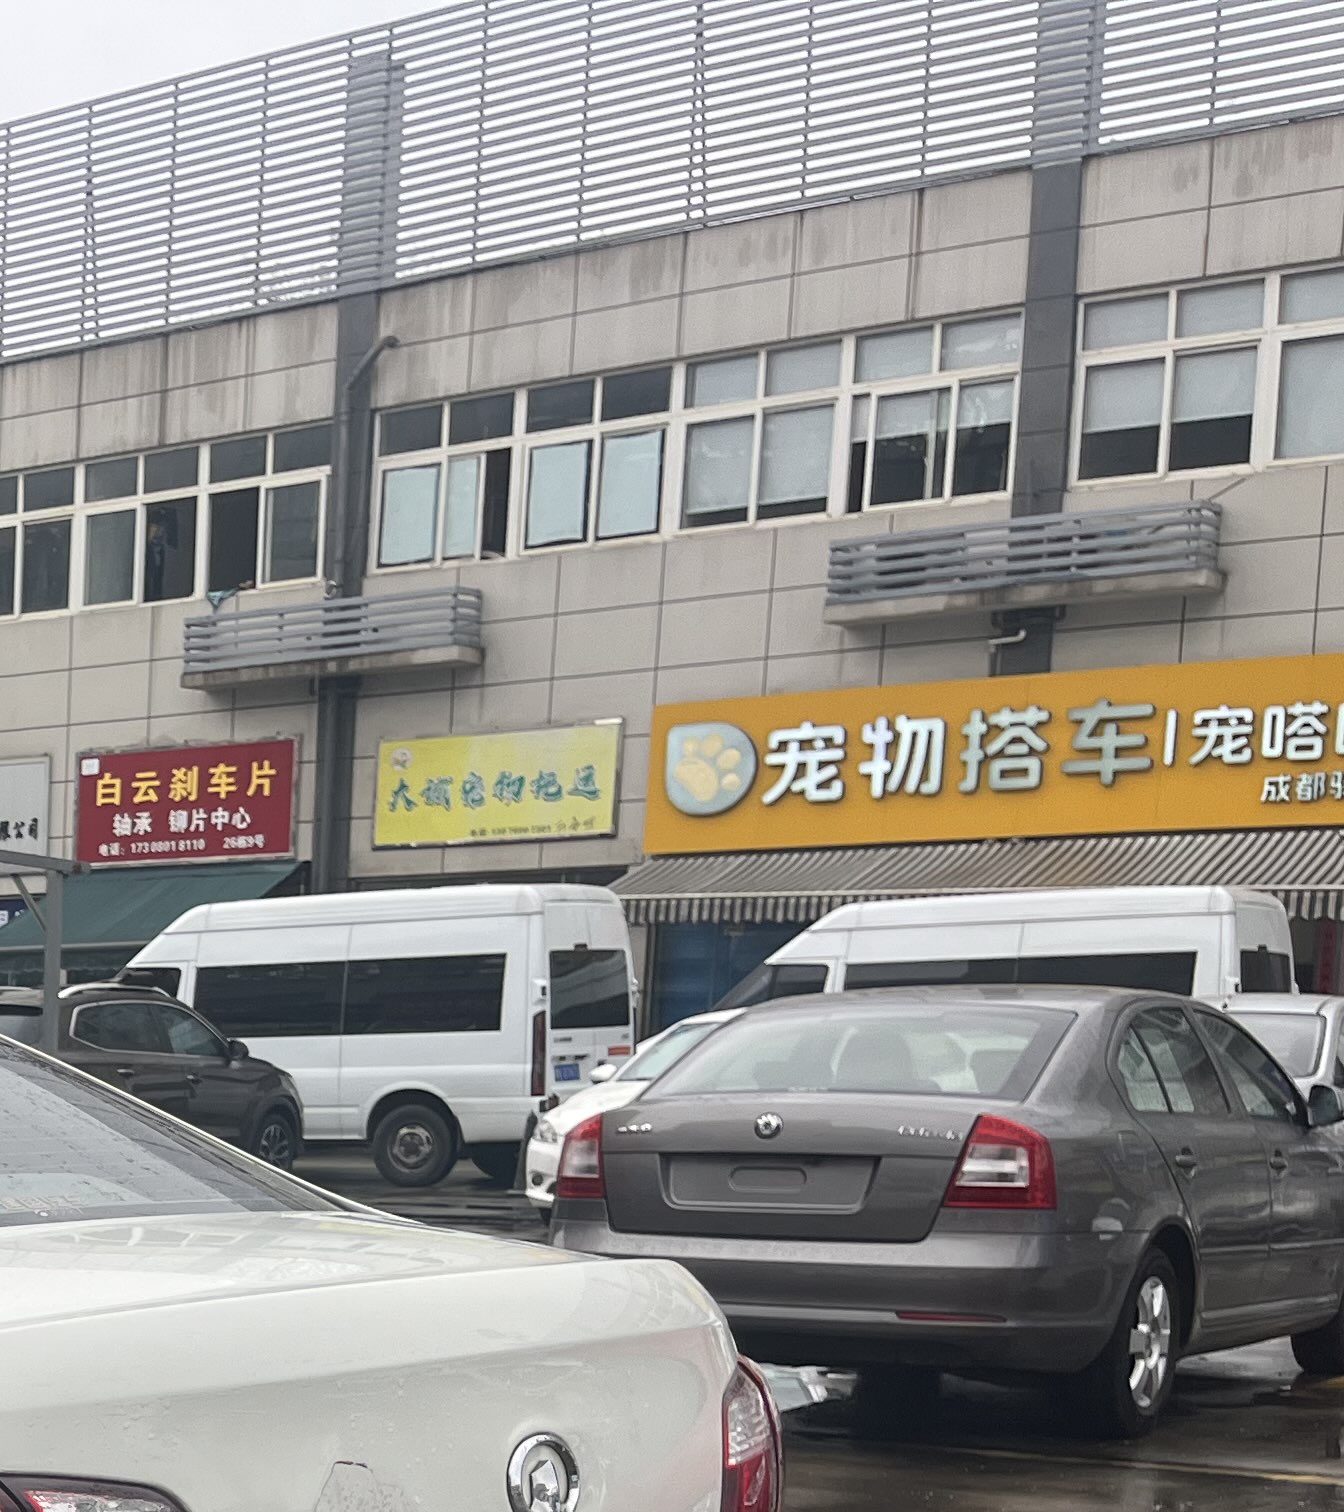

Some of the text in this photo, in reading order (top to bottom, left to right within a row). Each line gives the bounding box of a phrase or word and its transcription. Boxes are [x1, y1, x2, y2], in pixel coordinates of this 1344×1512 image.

[95, 759, 277, 807] 白云刹车片
[112, 811, 152, 837] 轴承
